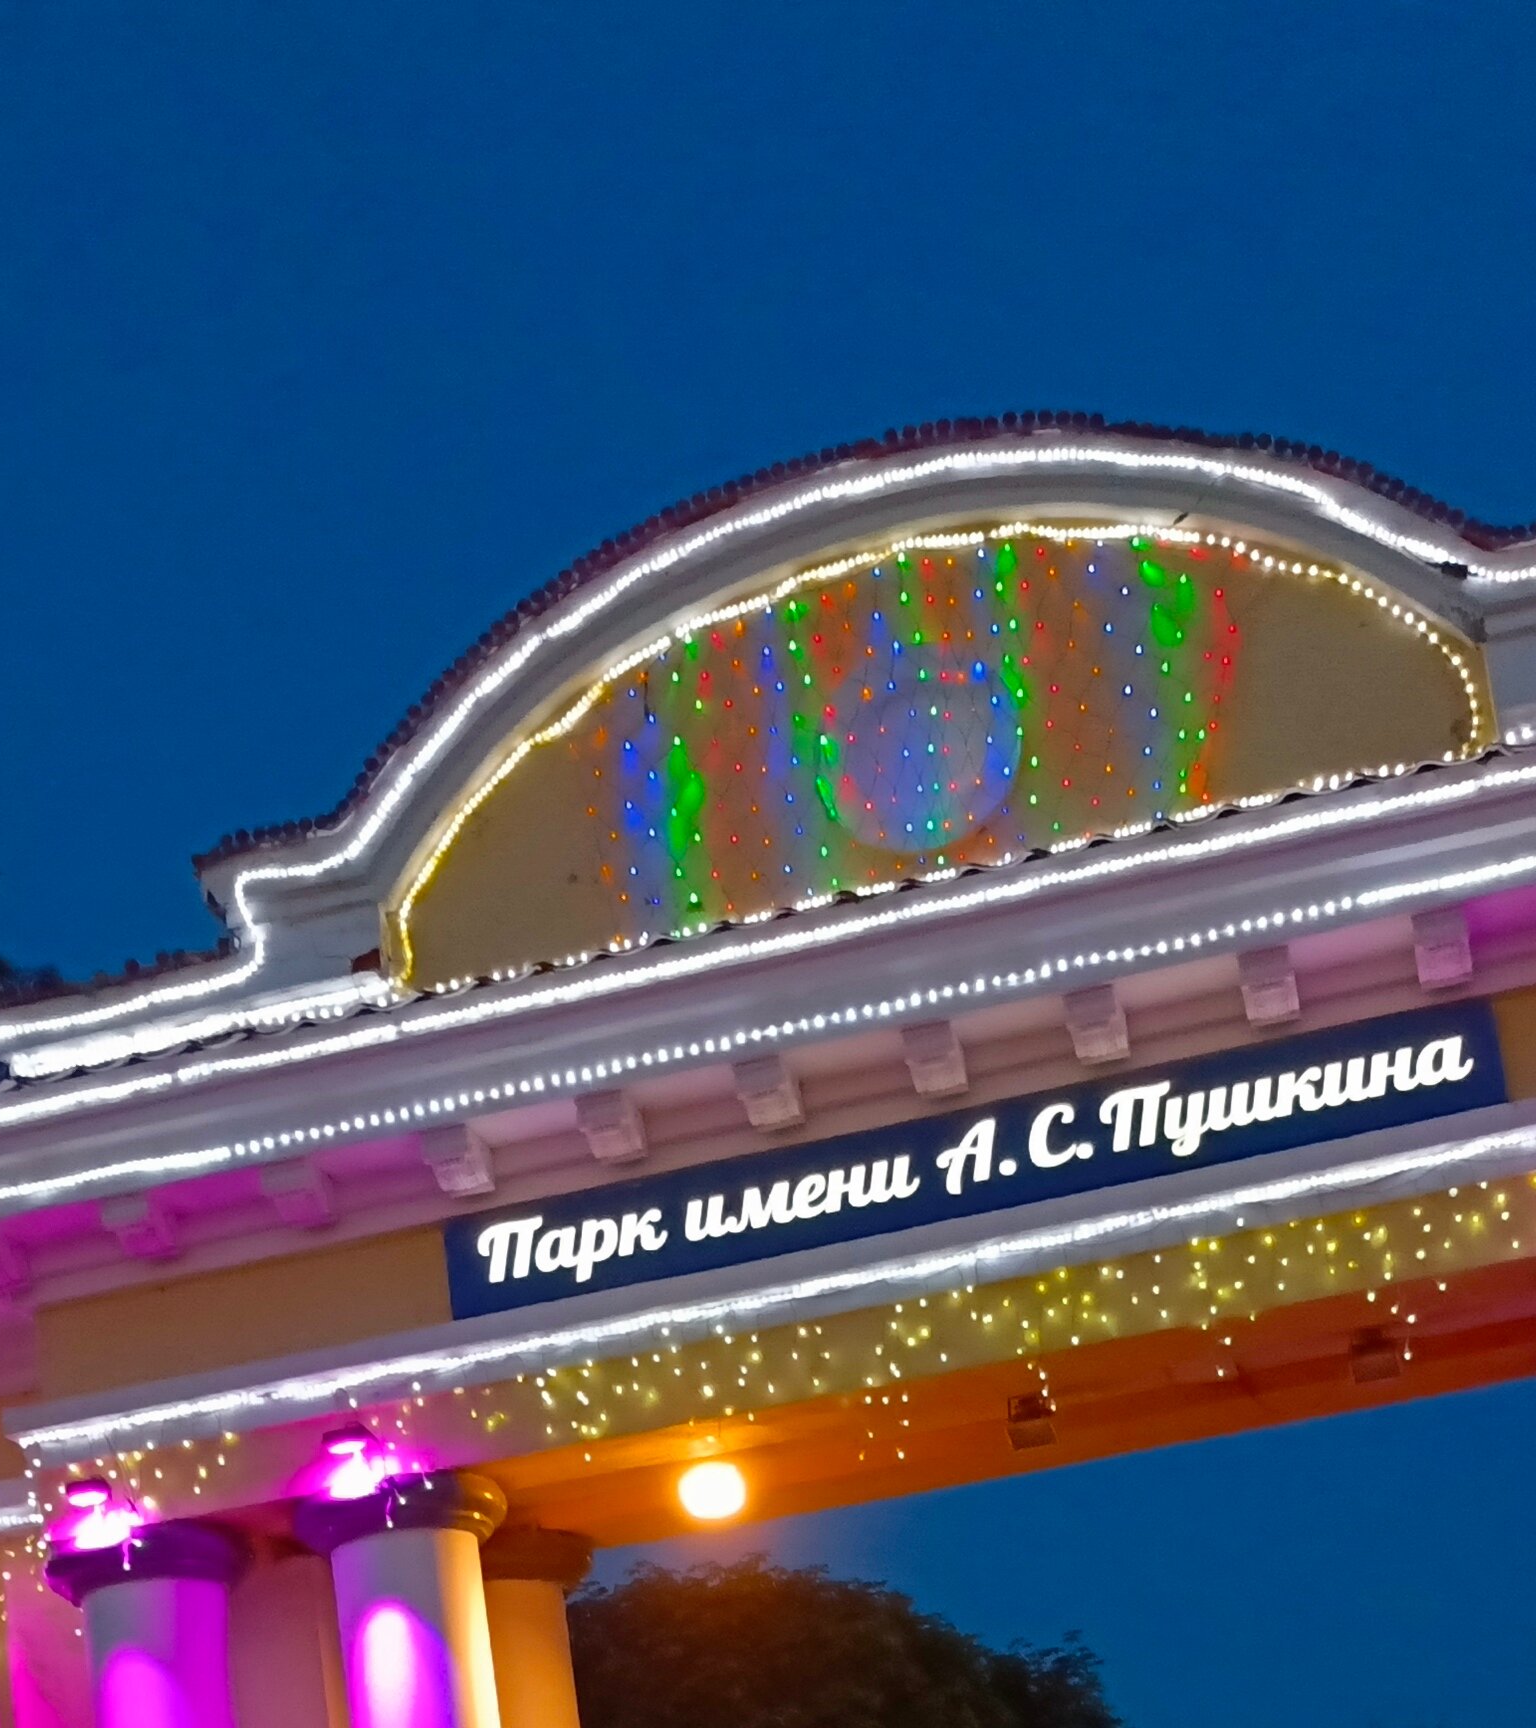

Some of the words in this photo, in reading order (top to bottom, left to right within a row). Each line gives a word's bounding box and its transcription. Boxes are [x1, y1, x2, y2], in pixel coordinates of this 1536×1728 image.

[477, 1208, 668, 1283] Парк
[684, 1155, 920, 1242] имени
[936, 1118, 1017, 1195] А.
[1099, 1035, 1474, 1157] Пушкина
